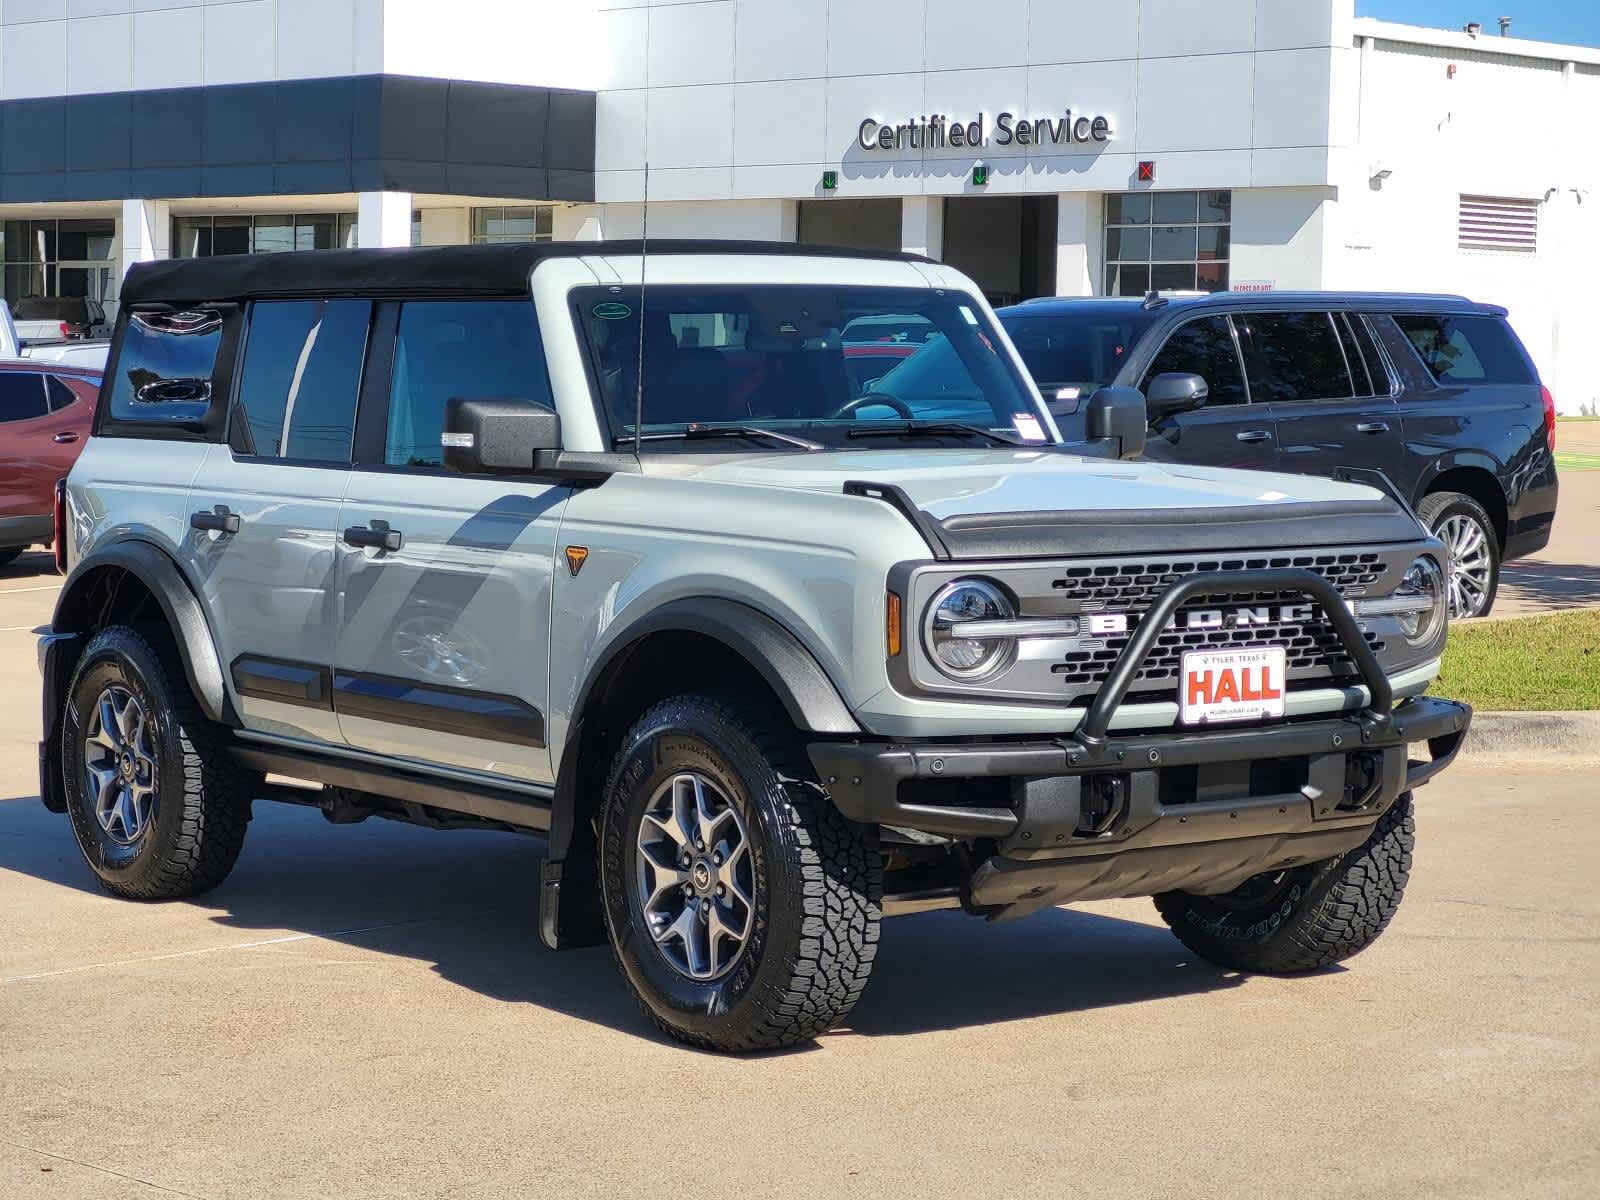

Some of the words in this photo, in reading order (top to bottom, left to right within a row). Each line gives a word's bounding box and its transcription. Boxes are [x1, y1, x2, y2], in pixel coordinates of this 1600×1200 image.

[858, 112, 983, 150] Certified
[996, 108, 1109, 146] Service
[1188, 666, 1281, 706] HALL
